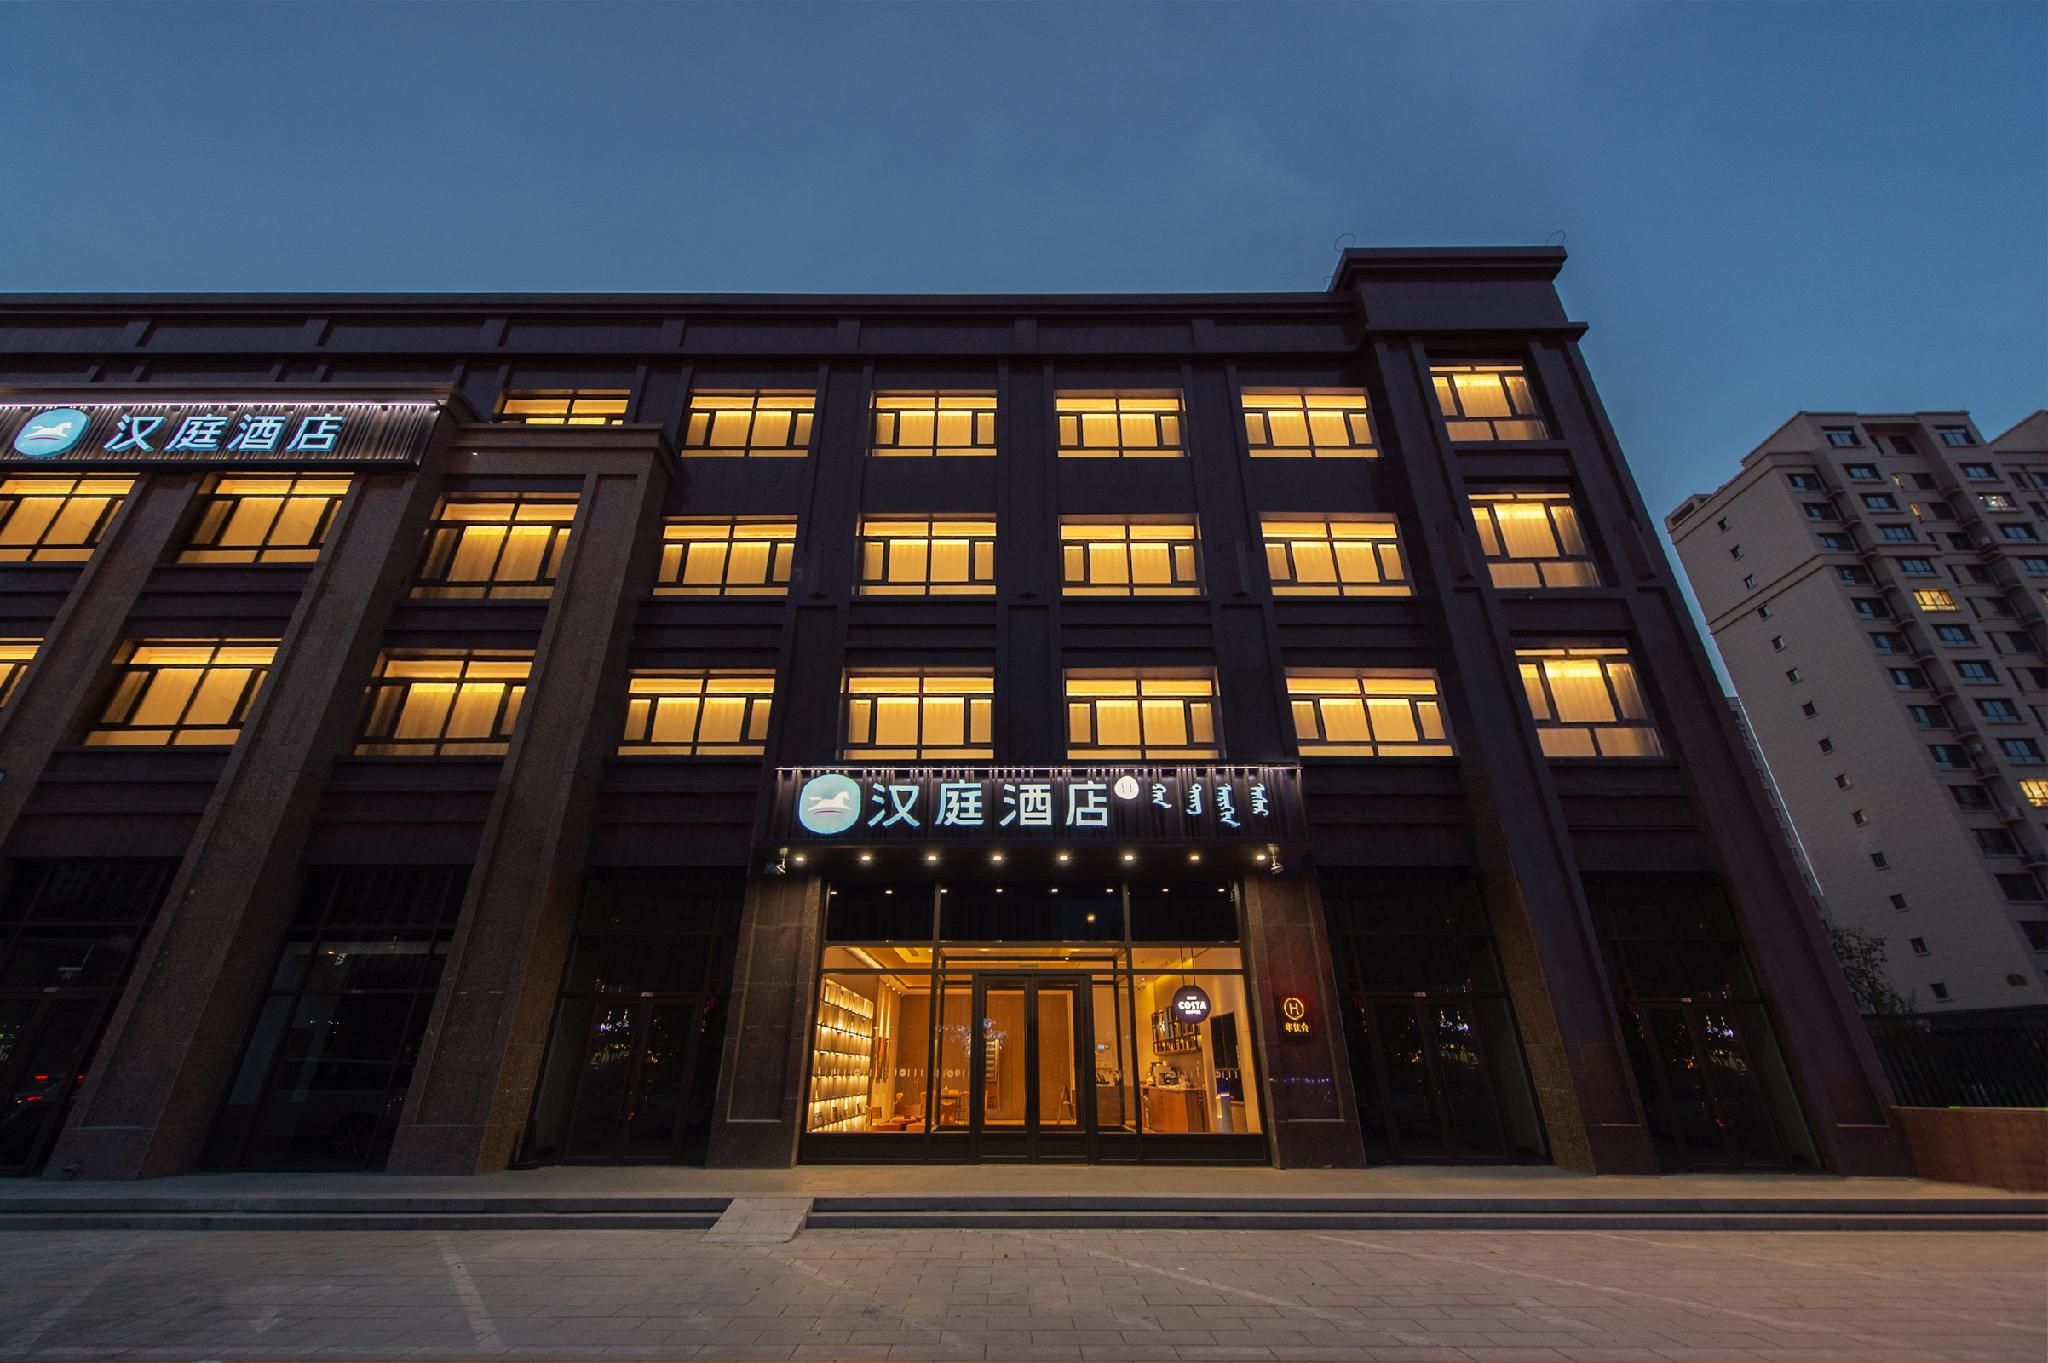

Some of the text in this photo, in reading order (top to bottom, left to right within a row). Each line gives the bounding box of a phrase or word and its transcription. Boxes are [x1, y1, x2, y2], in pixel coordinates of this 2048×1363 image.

[103, 413, 347, 452] 汉庭酒店
[867, 779, 1109, 828] 汉庭酒店
[1177, 1001, 1207, 1010] COSTA
